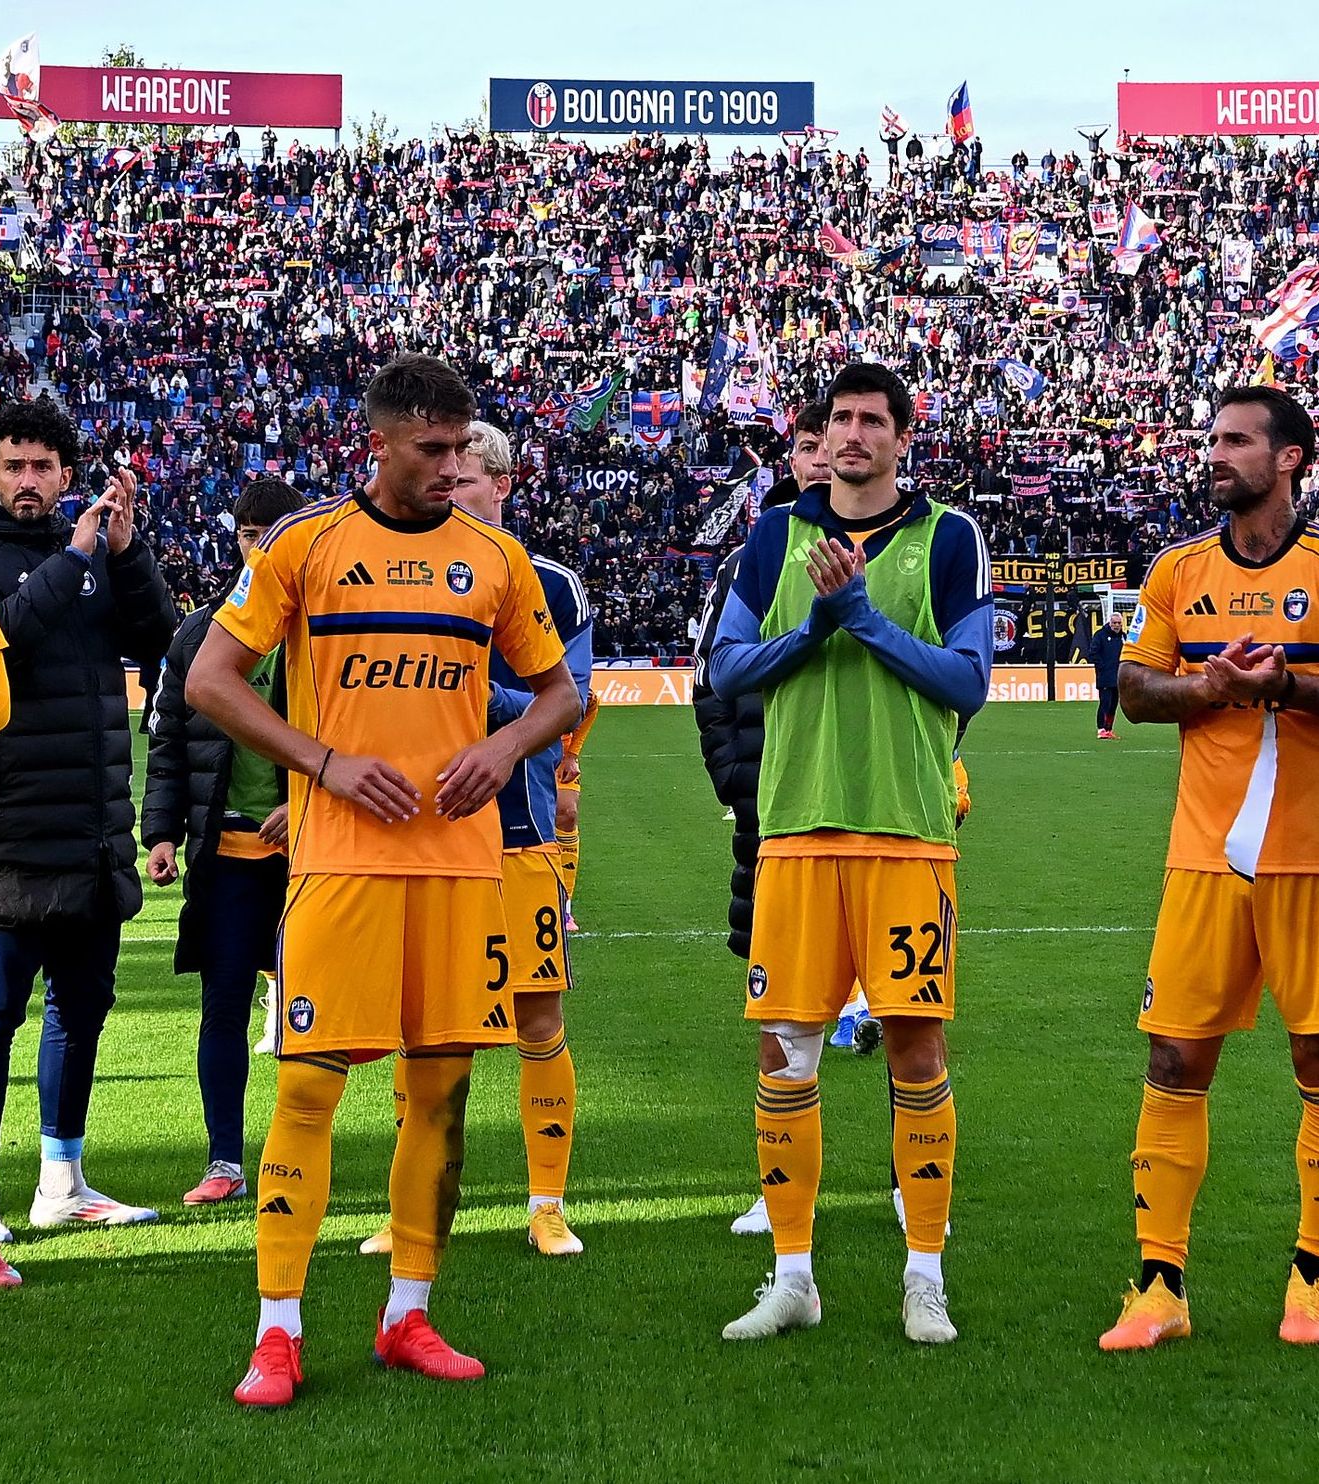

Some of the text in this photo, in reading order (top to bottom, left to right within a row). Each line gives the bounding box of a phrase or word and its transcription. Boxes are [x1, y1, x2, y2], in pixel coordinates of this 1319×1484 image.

[101, 75, 231, 115] WEAREONE
[564, 89, 778, 125] BOLOGNA FC 1909
[992, 558, 1126, 584] ettor Ostile
[339, 652, 477, 692] Cetilar
[534, 905, 558, 952] 8
[485, 934, 509, 992] 5
[889, 921, 944, 980] 32
[291, 1000, 311, 1010] PISA
[531, 1096, 567, 1108] PISA
[908, 1131, 950, 1145] PISA
[261, 1162, 303, 1181] PISA
